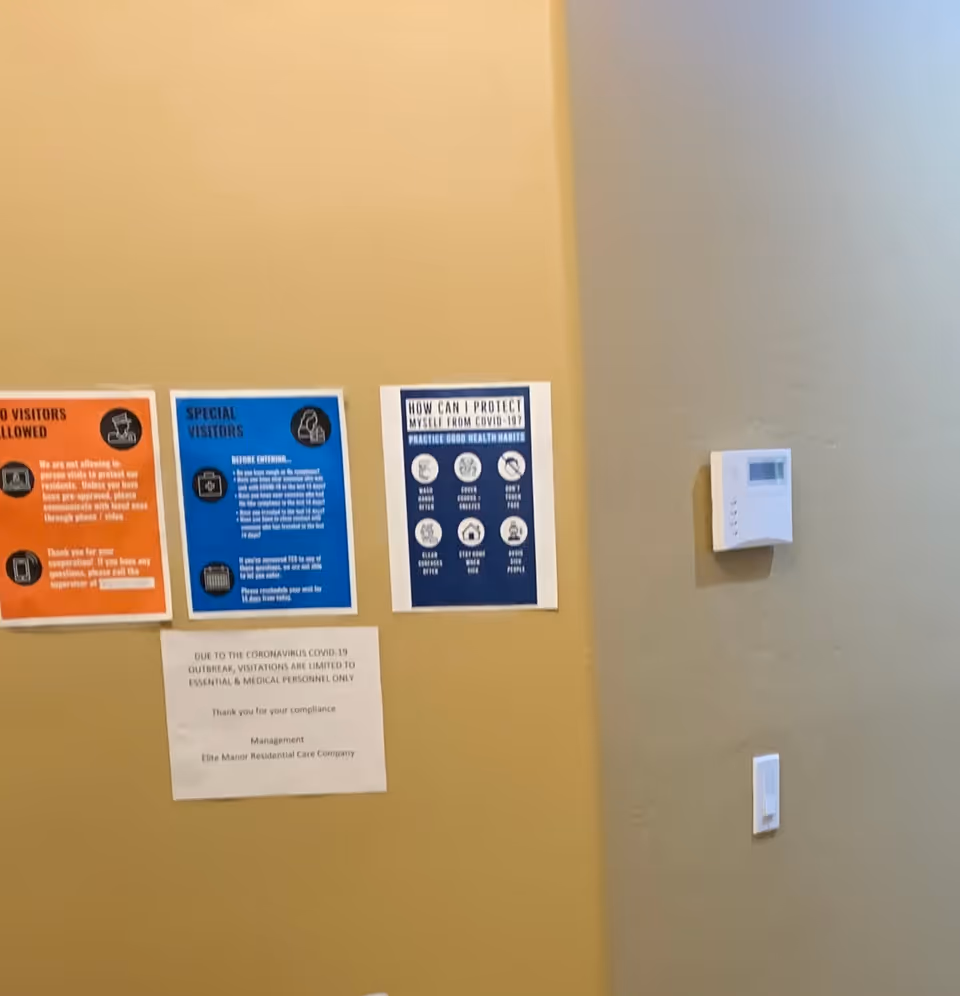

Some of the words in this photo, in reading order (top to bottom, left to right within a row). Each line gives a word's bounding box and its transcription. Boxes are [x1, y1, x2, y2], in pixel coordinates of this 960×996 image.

[186, 406, 236, 420] SPECIAL
[408, 401, 432, 415] HOW
[438, 401, 459, 414] CAN
[464, 401, 469, 414] I
[474, 400, 521, 414] PROTECT
[12, 408, 66, 421] VISITORS
[409, 417, 442, 429] MYSELF
[447, 416, 471, 428] FROM
[475, 416, 522, 426] COVID-19?
[0, 425, 47, 439] LLOWED
[188, 424, 244, 439] VISITORS
[194, 652, 211, 661] DUE
[214, 651, 226, 660] TO
[228, 651, 243, 660] THE
[246, 648, 307, 659] CORONAVIRUS
[188, 665, 236, 674] OUTBREAK,
[237, 662, 289, 673] VISITATIONS
[290, 662, 306, 671] ARE
[308, 661, 342, 670] LIMITED
[344, 660, 356, 670] TO
[188, 676, 232, 687] ESSENTIAL
[234, 677, 241, 686] &
[243, 675, 280, 685] MEDICAL
[282, 674, 331, 684] PERSONNEL
[332, 673, 354, 683] ONLY
[212, 707, 237, 717] Thank
[238, 708, 254, 717] you
[256, 706, 267, 715] for
[269, 707, 288, 716] your
[290, 704, 336, 715] compliance
[250, 736, 304, 746] Management
[201, 753, 219, 762] Elite
[221, 752, 248, 762] Manor
[250, 750, 295, 761] Residential
[296, 750, 315, 759] Care
[316, 749, 355, 759] Company
